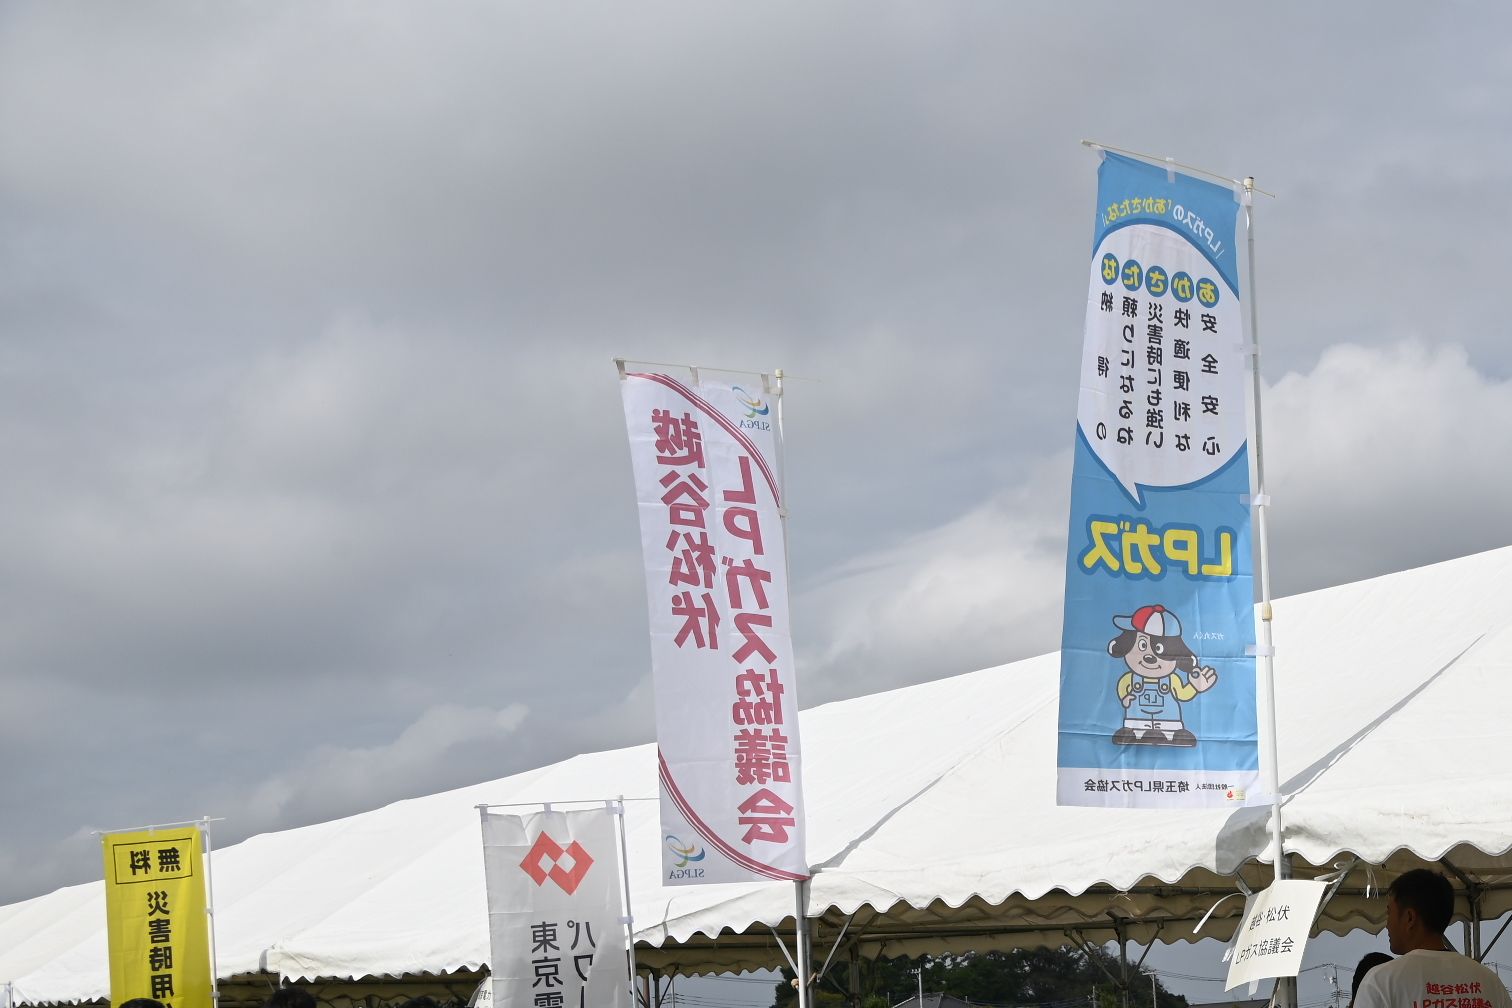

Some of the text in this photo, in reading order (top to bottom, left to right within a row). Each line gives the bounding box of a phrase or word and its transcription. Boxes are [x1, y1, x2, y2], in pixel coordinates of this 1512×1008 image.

[1235, 936, 1294, 965] LPガス協議会
[1426, 981, 1482, 995] 越谷松伏
